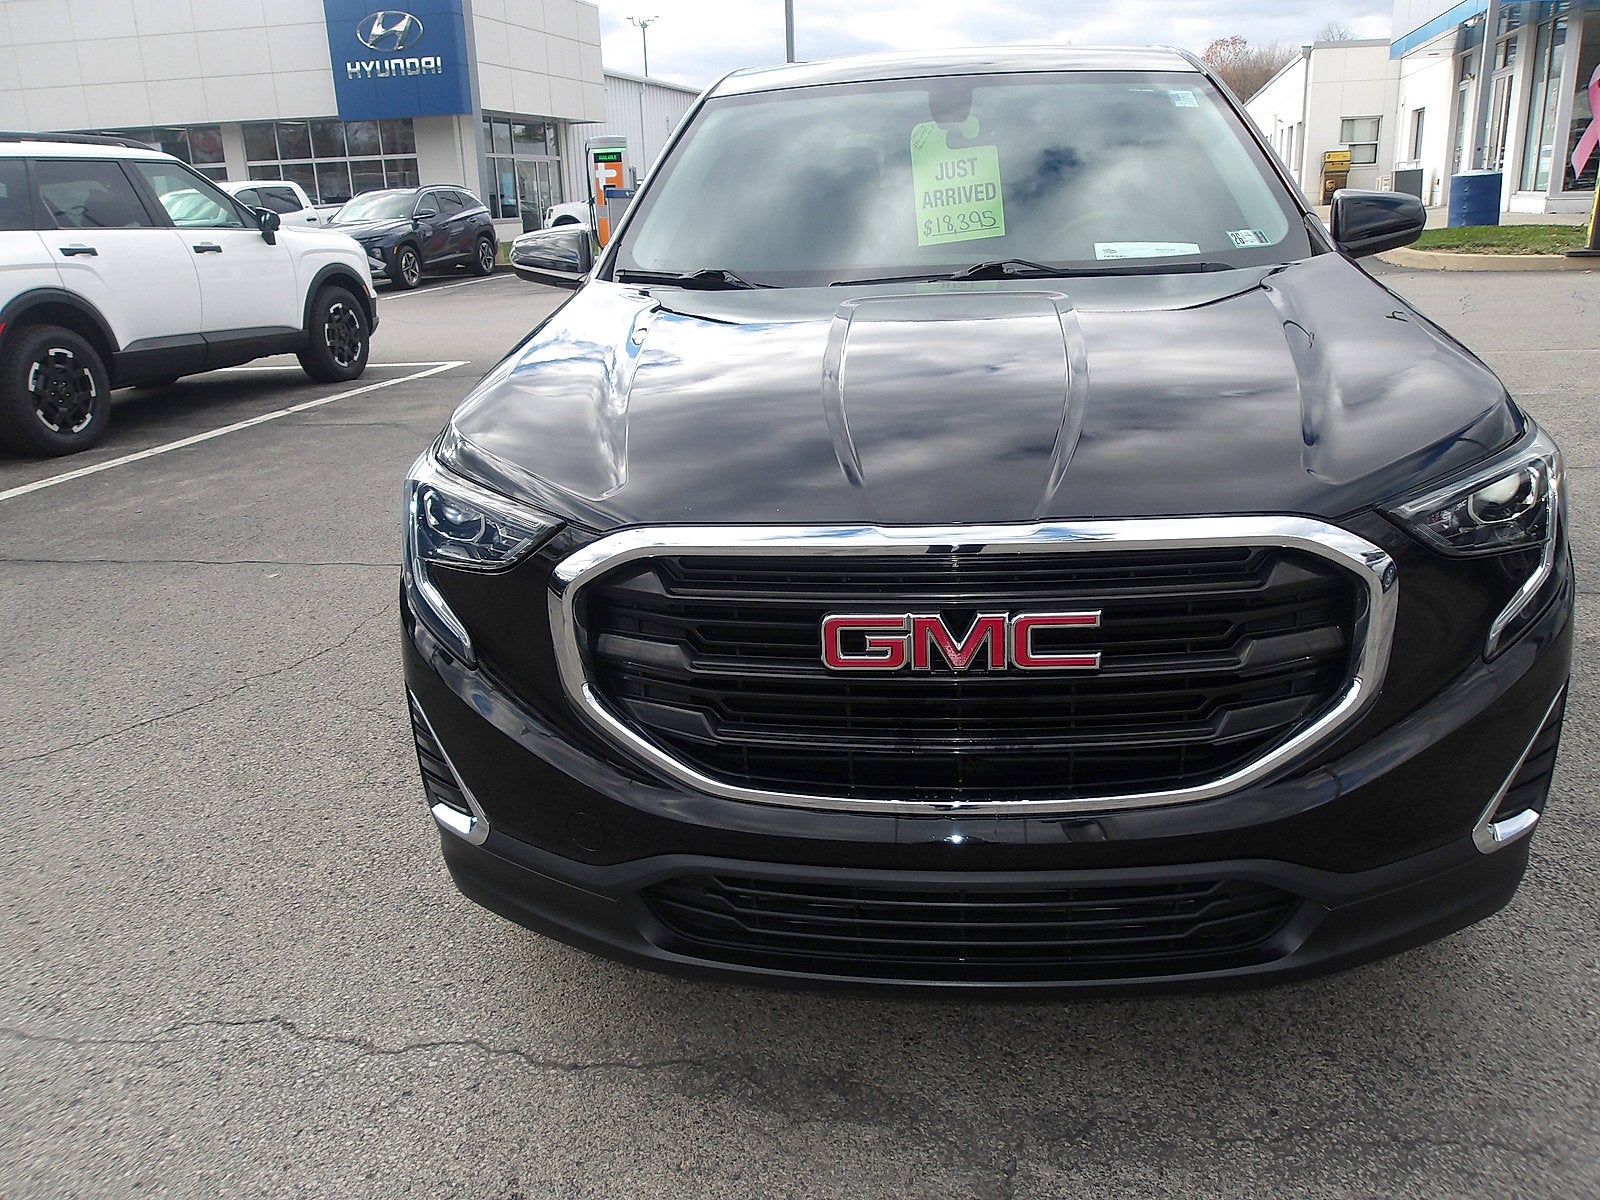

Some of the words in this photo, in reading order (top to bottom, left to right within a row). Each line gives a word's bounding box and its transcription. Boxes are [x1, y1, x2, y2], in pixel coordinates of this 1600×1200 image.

[346, 57, 442, 79] HYUNDAI
[935, 158, 977, 181] JUST
[922, 182, 997, 209] ARRIVED
[923, 210, 997, 237] $18,395
[821, 610, 1102, 671] GMC
